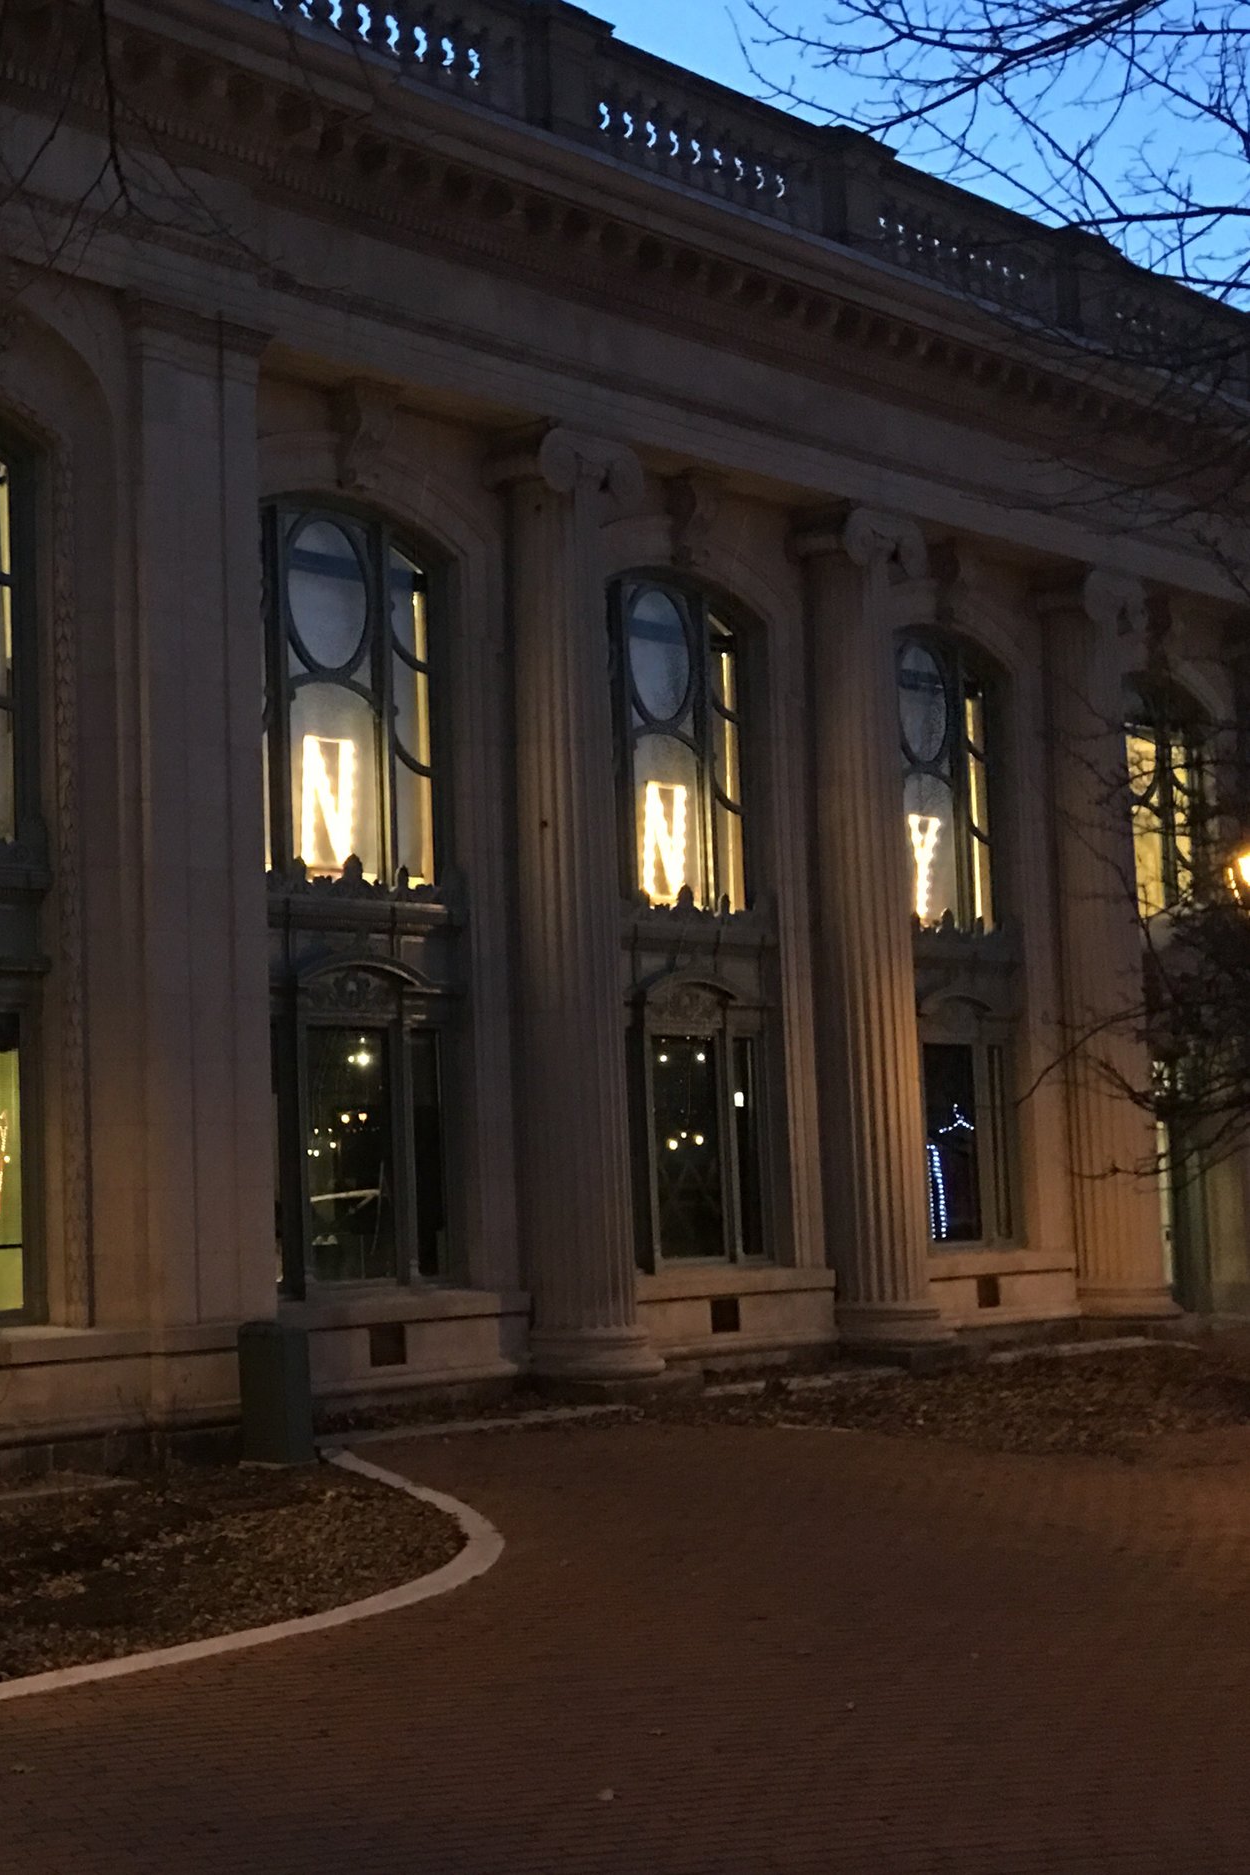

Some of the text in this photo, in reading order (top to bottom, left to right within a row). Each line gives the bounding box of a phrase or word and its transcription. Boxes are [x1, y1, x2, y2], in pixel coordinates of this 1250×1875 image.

[299, 734, 356, 869] N
[641, 779, 688, 905] N
[906, 813, 942, 924] Y
